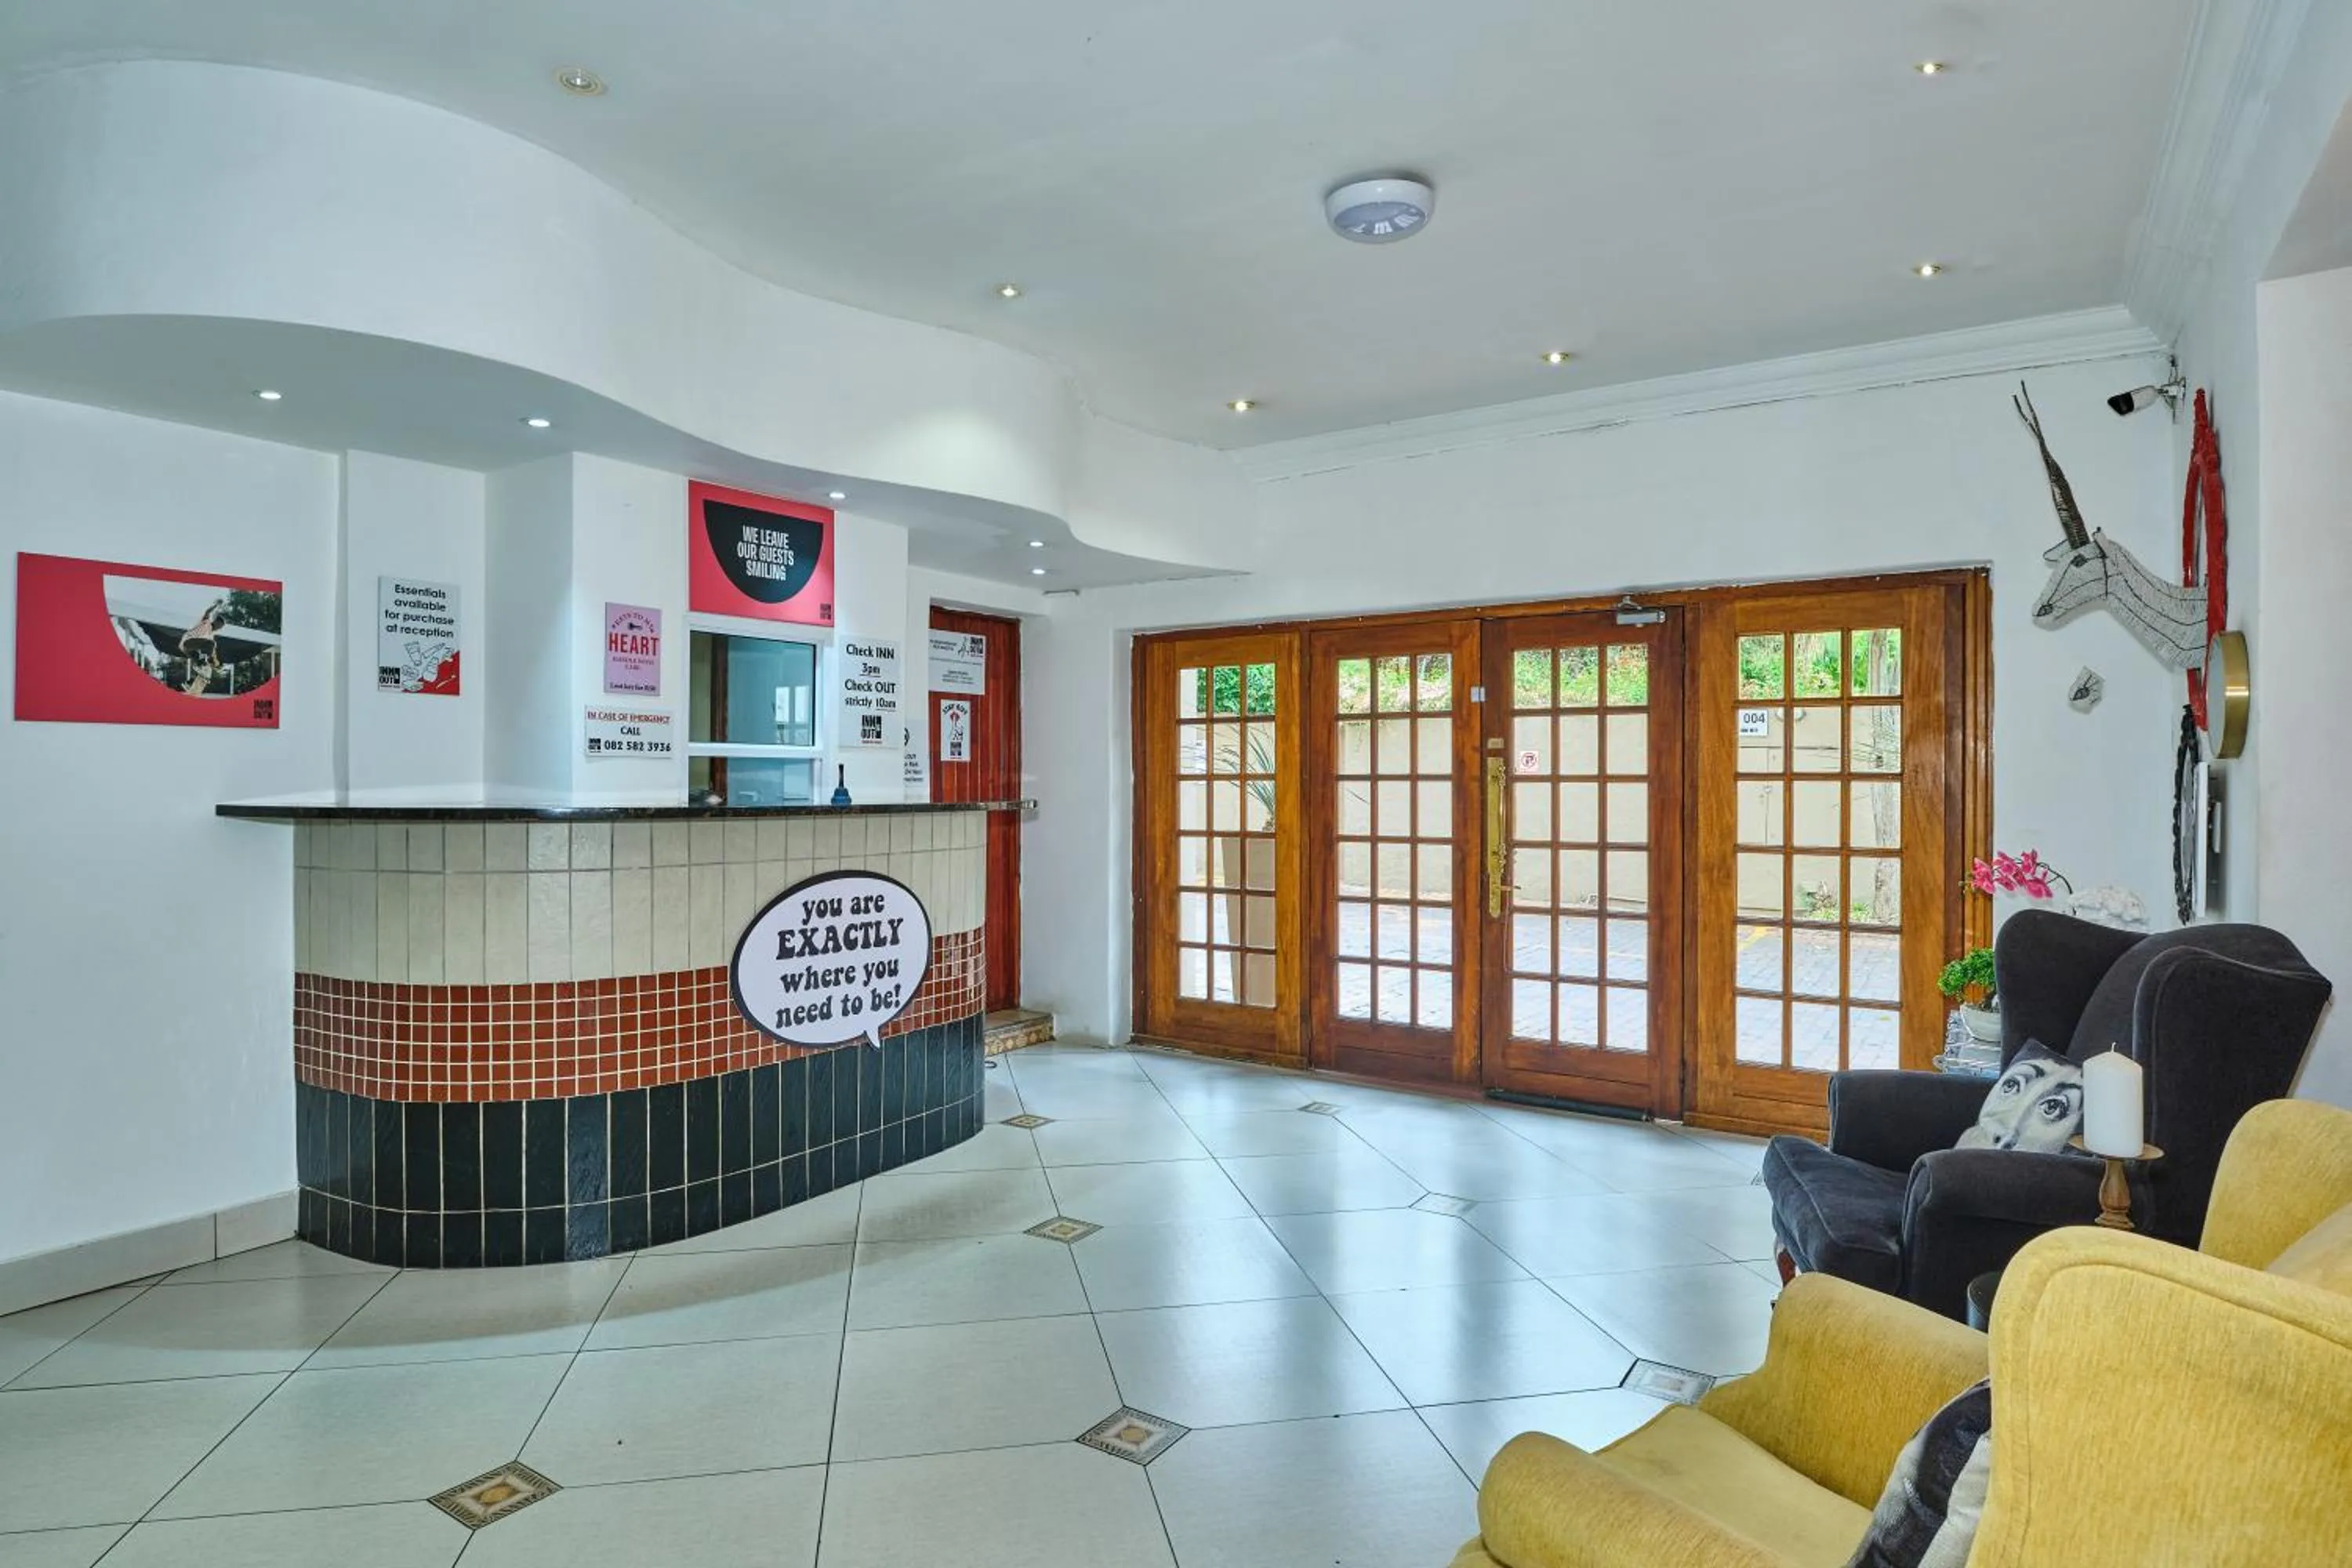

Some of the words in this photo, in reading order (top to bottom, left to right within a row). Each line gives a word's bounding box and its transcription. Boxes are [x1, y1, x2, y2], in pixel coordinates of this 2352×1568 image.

[742, 525, 759, 543] WE
[760, 528, 789, 549] LEAVE
[737, 542, 757, 561] OUR
[758, 546, 794, 566] GUESTS
[746, 560, 786, 581] SMILING
[394, 584, 446, 599] Essentials
[394, 597, 446, 612] available
[385, 609, 400, 619] for
[402, 612, 455, 625] purchase
[386, 624, 397, 633] at
[401, 625, 454, 638] reception
[608, 631, 659, 656] HEART
[846, 644, 874, 657] Check
[875, 647, 895, 659] INN
[862, 662, 880, 675] 3pm
[844, 678, 873, 691] Check
[874, 681, 896, 694] OUT
[844, 695, 873, 708] strictly
[876, 697, 896, 709] 10am
[598, 712, 616, 721] CASE
[616, 713, 629, 721] OF
[630, 714, 670, 724] EMERGENCY
[1743, 713, 1766, 724] 004
[620, 726, 641, 736] CALL
[604, 739, 624, 750] 082
[626, 741, 644, 752] 582
[647, 742, 672, 752] 3936
[802, 897, 843, 926] you
[850, 894, 885, 916] are
[775, 917, 904, 960] EXACTLY
[780, 964, 856, 994] where
[862, 958, 899, 987] you
[775, 995, 833, 1029] need
[840, 993, 864, 1018] to
[870, 983, 902, 1012] be!
